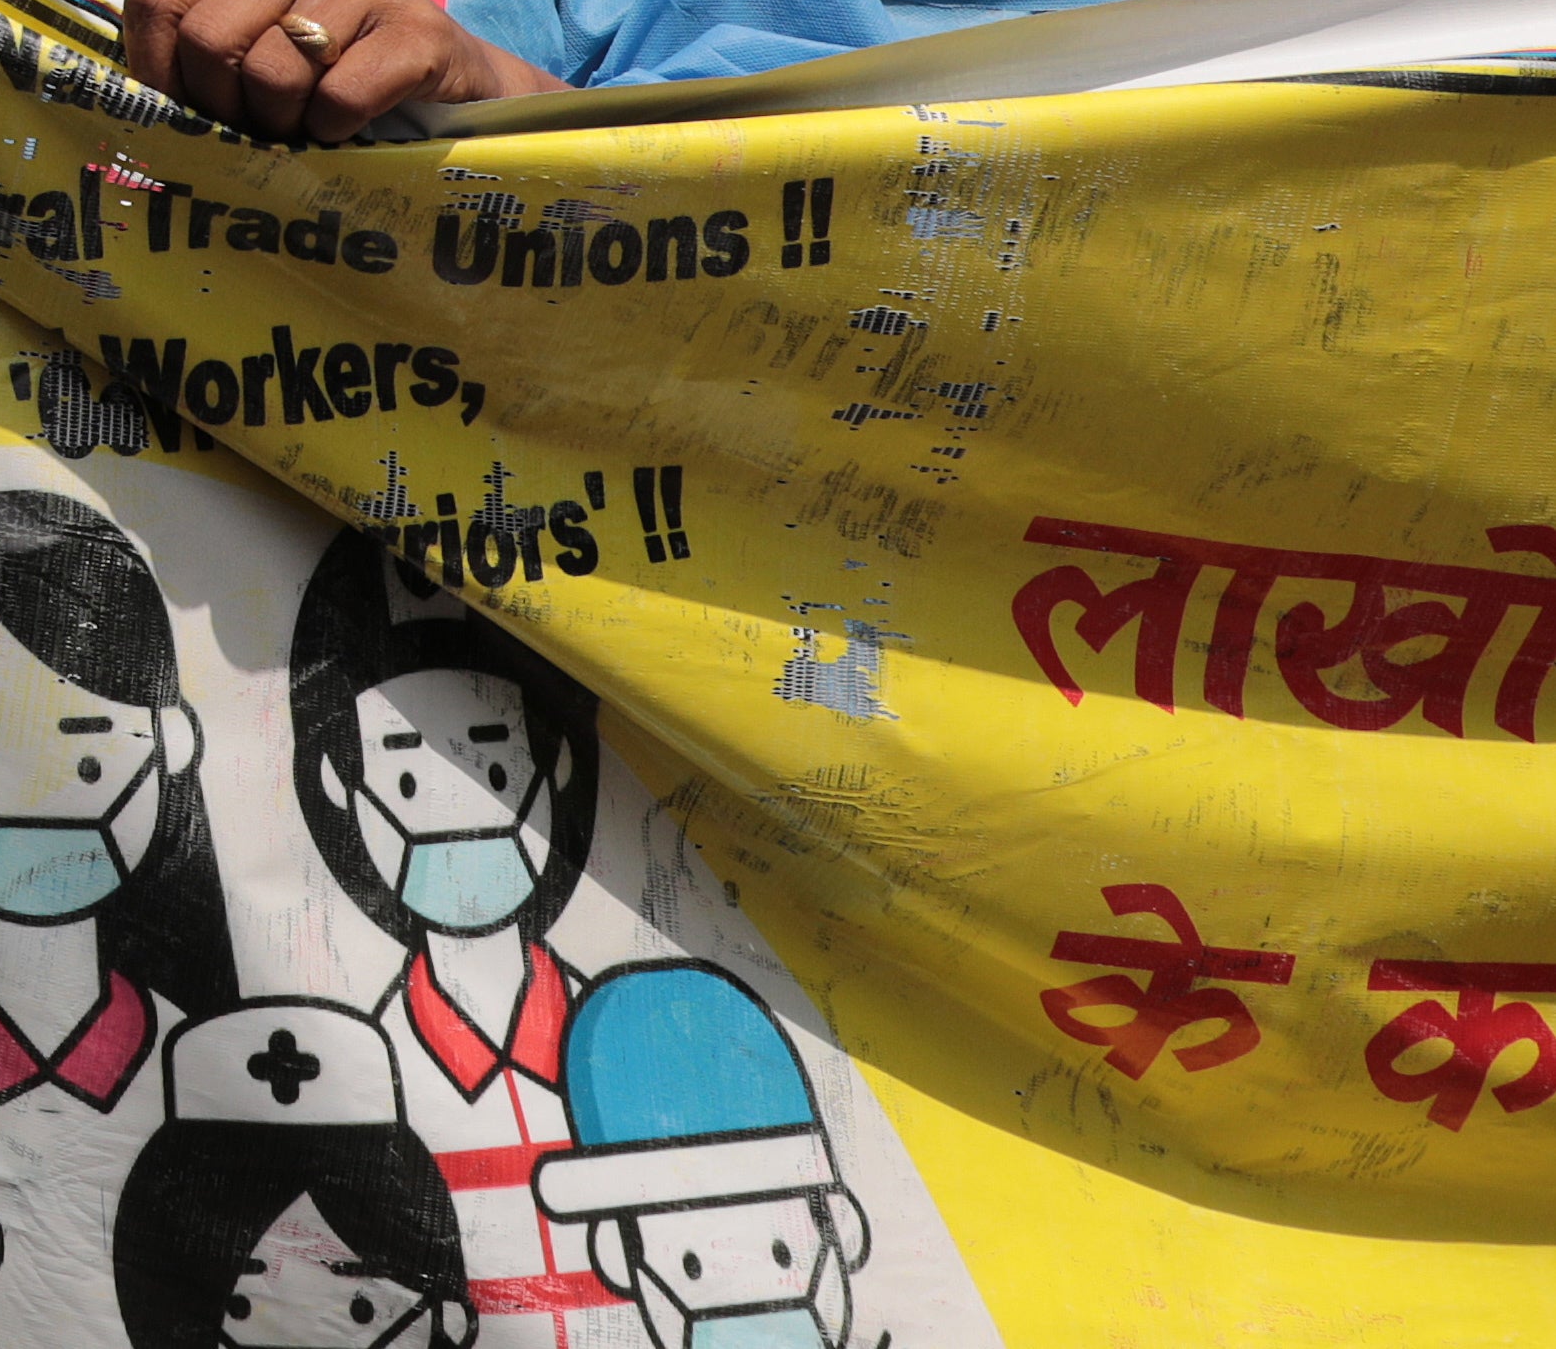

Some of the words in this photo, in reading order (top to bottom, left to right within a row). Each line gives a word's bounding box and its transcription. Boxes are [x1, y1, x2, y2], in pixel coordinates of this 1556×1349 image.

[145, 180, 399, 276] Trade
[431, 198, 752, 289] Unions
[779, 176, 836, 270] !!
[99, 324, 487, 428] Workers,
[632, 465, 691, 564] !!
[1039, 881, 1296, 1081] के
